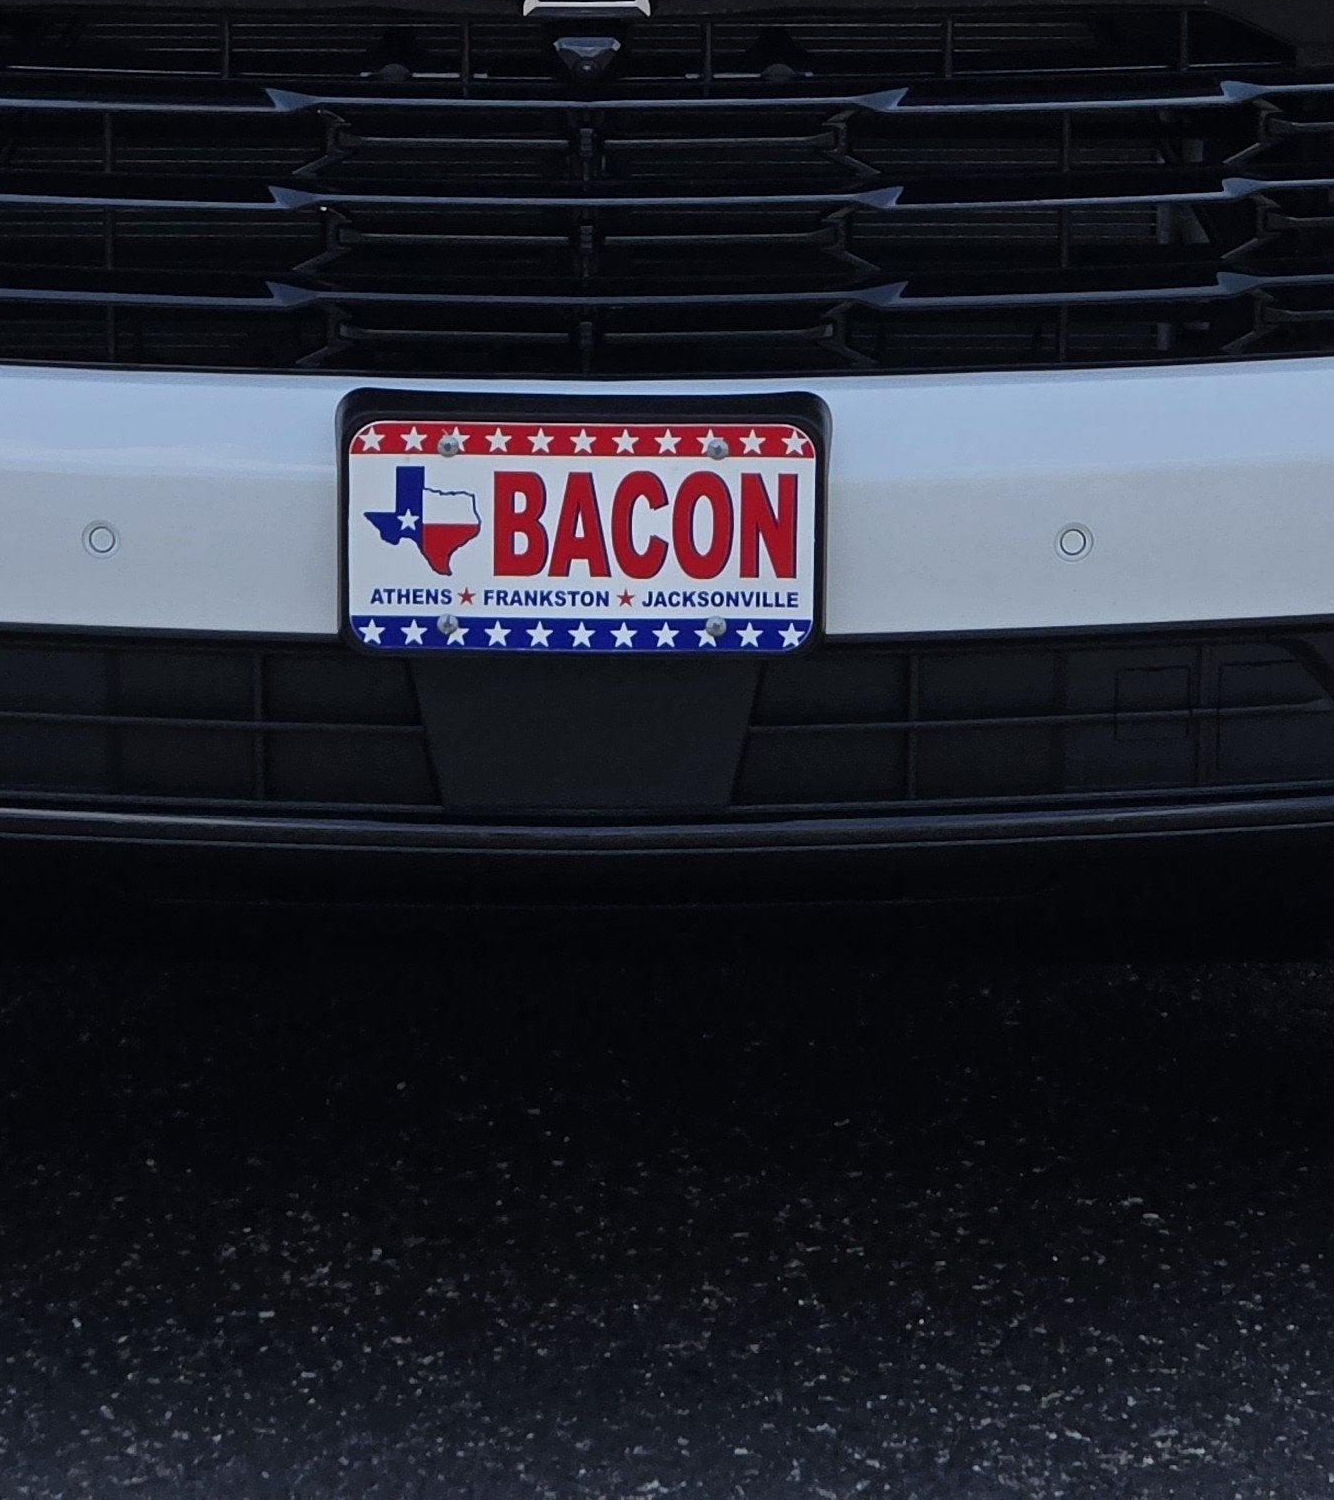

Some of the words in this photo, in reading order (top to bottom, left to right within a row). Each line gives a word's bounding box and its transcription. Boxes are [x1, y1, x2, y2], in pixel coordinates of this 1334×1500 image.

[493, 470, 799, 579] BACON
[370, 588, 453, 605] ATHENS
[483, 589, 610, 607] FRANKSTON
[642, 591, 799, 608] JACKSONVILLE
